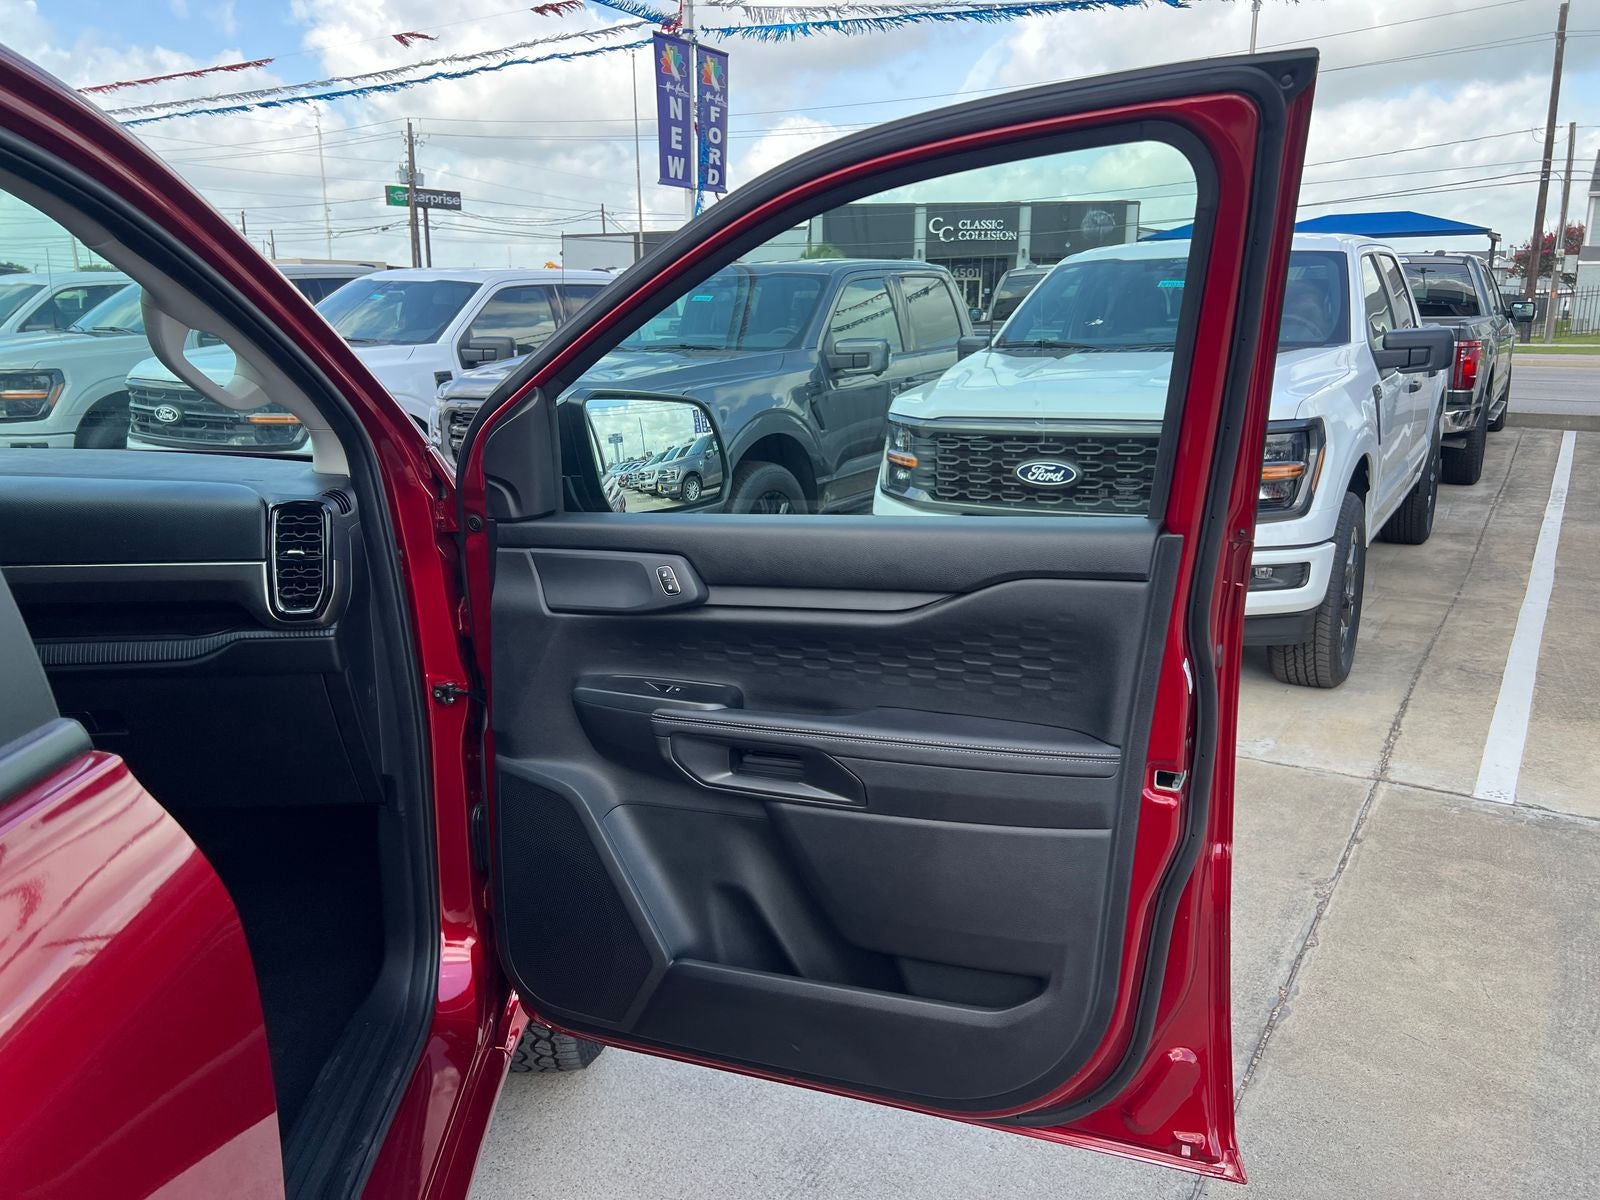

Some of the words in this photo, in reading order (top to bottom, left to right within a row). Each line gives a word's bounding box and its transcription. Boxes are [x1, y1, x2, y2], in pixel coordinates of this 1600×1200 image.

[668, 96, 685, 180] NEW
[707, 106, 721, 185] FORD
[958, 219, 1004, 230] CLASSIC
[958, 230, 1017, 241] COLLISION
[953, 268, 980, 278] 4501
[1027, 464, 1065, 482] Ford
